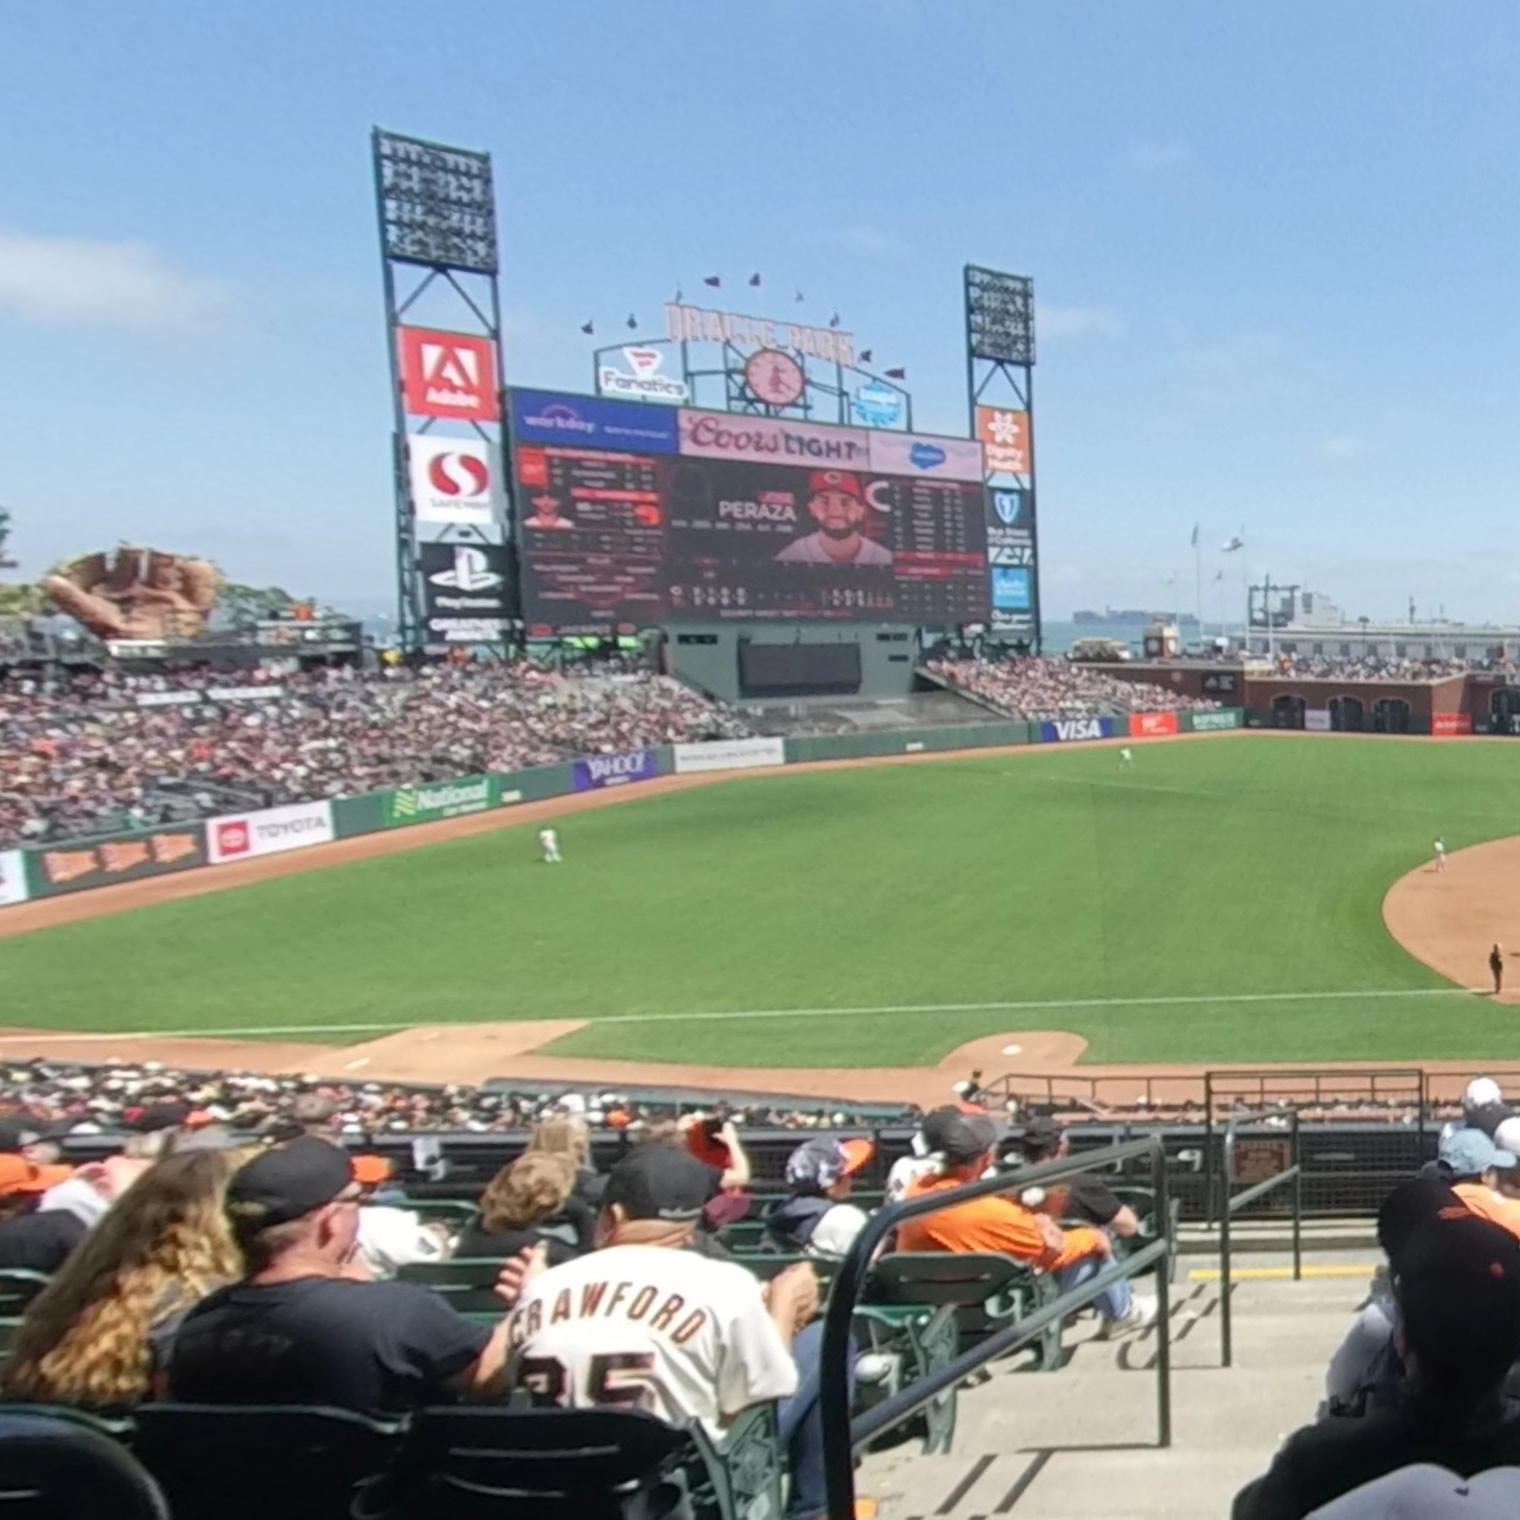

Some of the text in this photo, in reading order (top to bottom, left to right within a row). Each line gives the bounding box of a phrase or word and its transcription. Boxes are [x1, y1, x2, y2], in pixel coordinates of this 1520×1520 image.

[788, 323, 855, 368] PARK
[602, 369, 686, 397] Fanatics
[426, 387, 480, 409] Adobe
[523, 413, 595, 434] workday
[687, 416, 859, 461] Coors LIGHT
[719, 501, 797, 521] PERAZA
[1053, 720, 1102, 740] VISA
[587, 752, 644, 779] YAHOO!
[417, 780, 488, 810] National
[256, 815, 328, 837] TOYOTA
[510, 1279, 707, 1346] CRAWFORD
